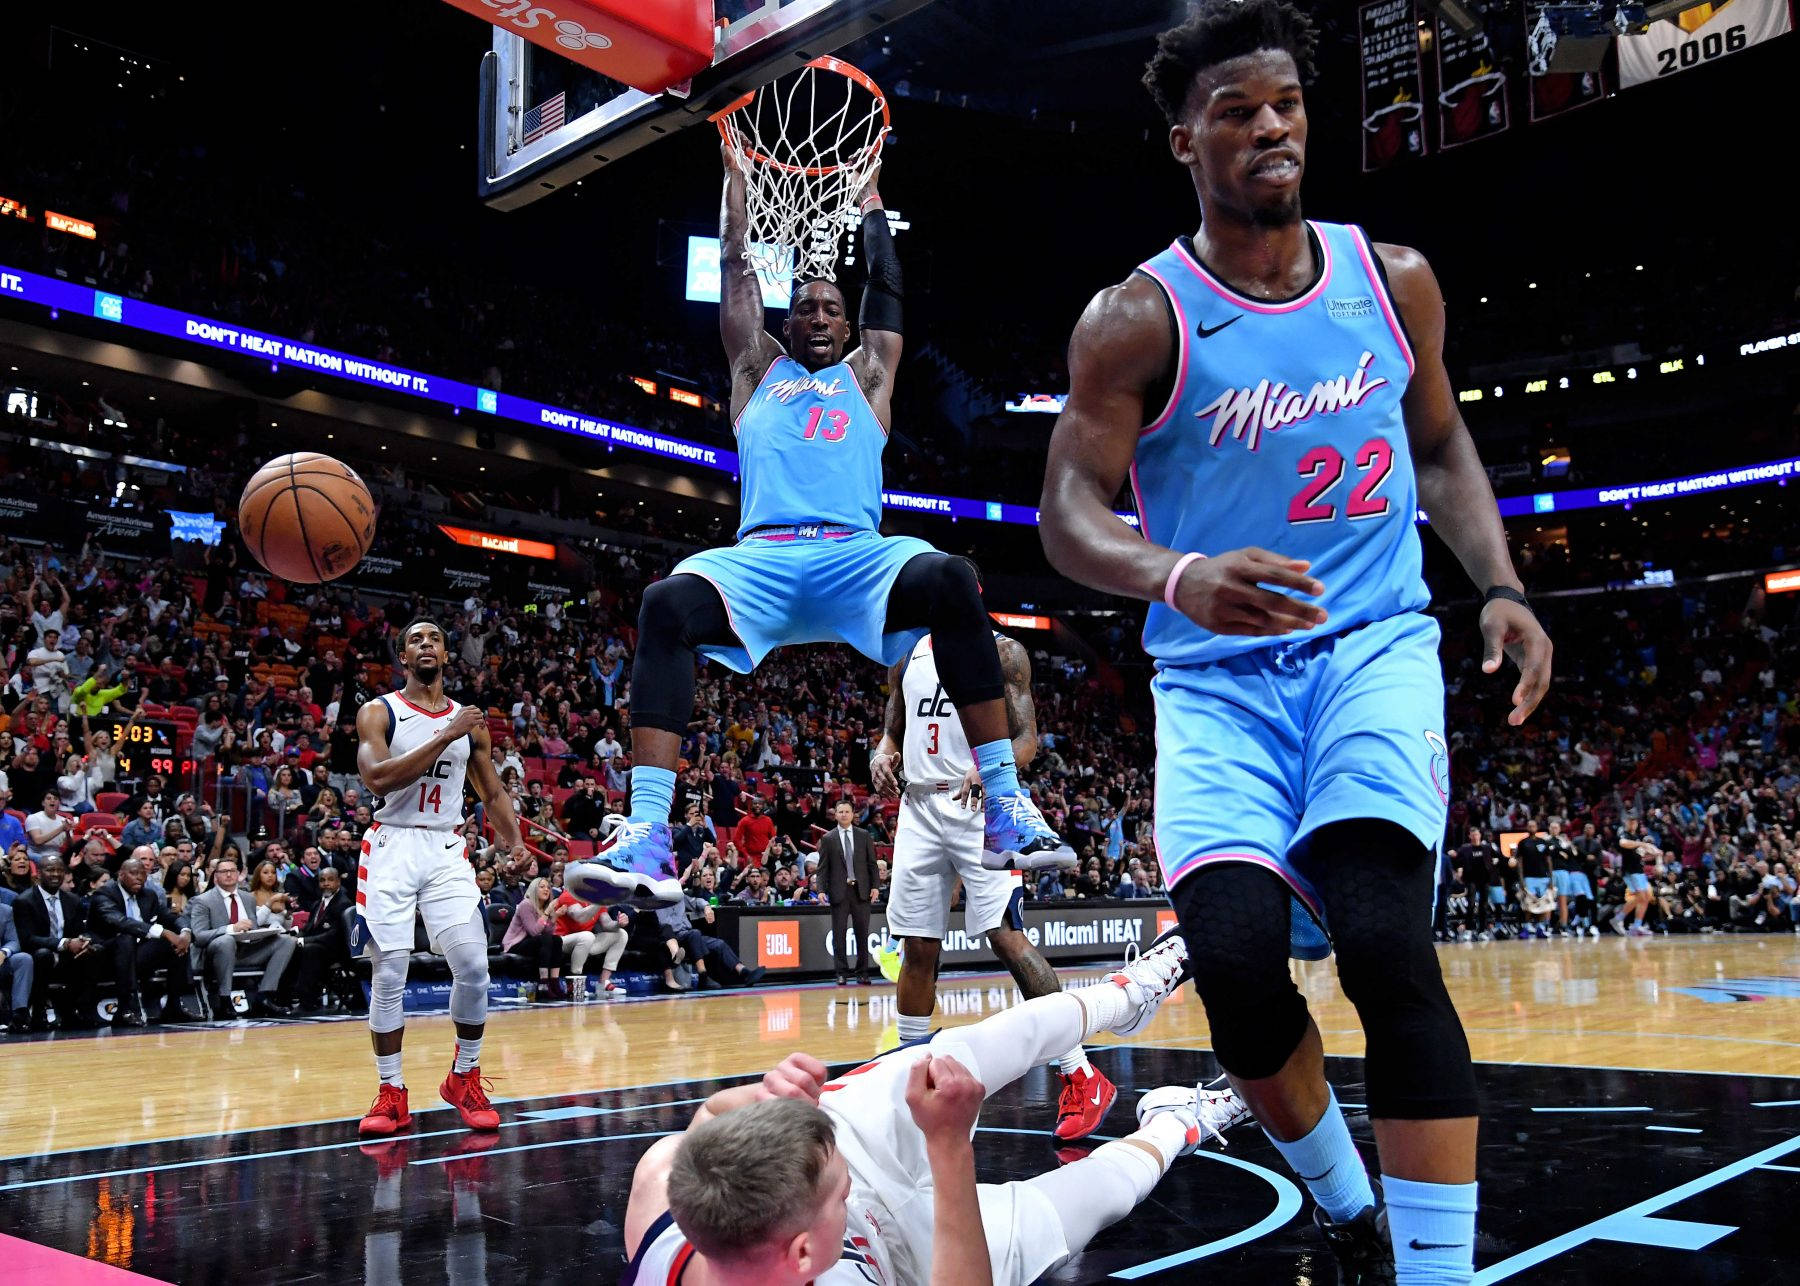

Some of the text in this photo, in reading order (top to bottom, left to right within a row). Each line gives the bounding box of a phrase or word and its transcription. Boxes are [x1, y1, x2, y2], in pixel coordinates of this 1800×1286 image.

[1657, 24, 1746, 77] 2006
[1, 272, 24, 293] IT.
[1326, 299, 1373, 311] Ultimate
[1332, 309, 1373, 318] SOFTWARE
[187, 320, 429, 393] DON'T HEAT NATION WITHOUT IT.
[1741, 336, 1787, 356] PLAYER
[766, 376, 849, 406] Miami
[1525, 379, 1548, 393] AST
[1559, 377, 1569, 389] 2
[1592, 371, 1616, 384] STL
[1193, 350, 1388, 454] Miami
[541, 409, 717, 464] DON'T HEAT NATION WITHOUT IT.
[803, 406, 851, 442] 13
[1286, 437, 1394, 525] 22
[1598, 486, 1640, 503] DON'T
[1641, 482, 1677, 498] HEAT
[1677, 473, 1728, 493] NATION
[1728, 461, 1793, 484] WITHOUT
[889, 493, 938, 510] WITHOUT
[938, 499, 951, 512] IT.
[94, 521, 141, 537] Arena
[357, 560, 393, 575] Arena
[917, 682, 953, 718] dc
[927, 723, 939, 755] 3
[119, 758, 131, 772] 4
[151, 758, 173, 774] 99
[418, 782, 442, 813] 14
[766, 933, 793, 956] JBL
[1044, 920, 1099, 946] Miami
[1102, 918, 1143, 943] HEAT
